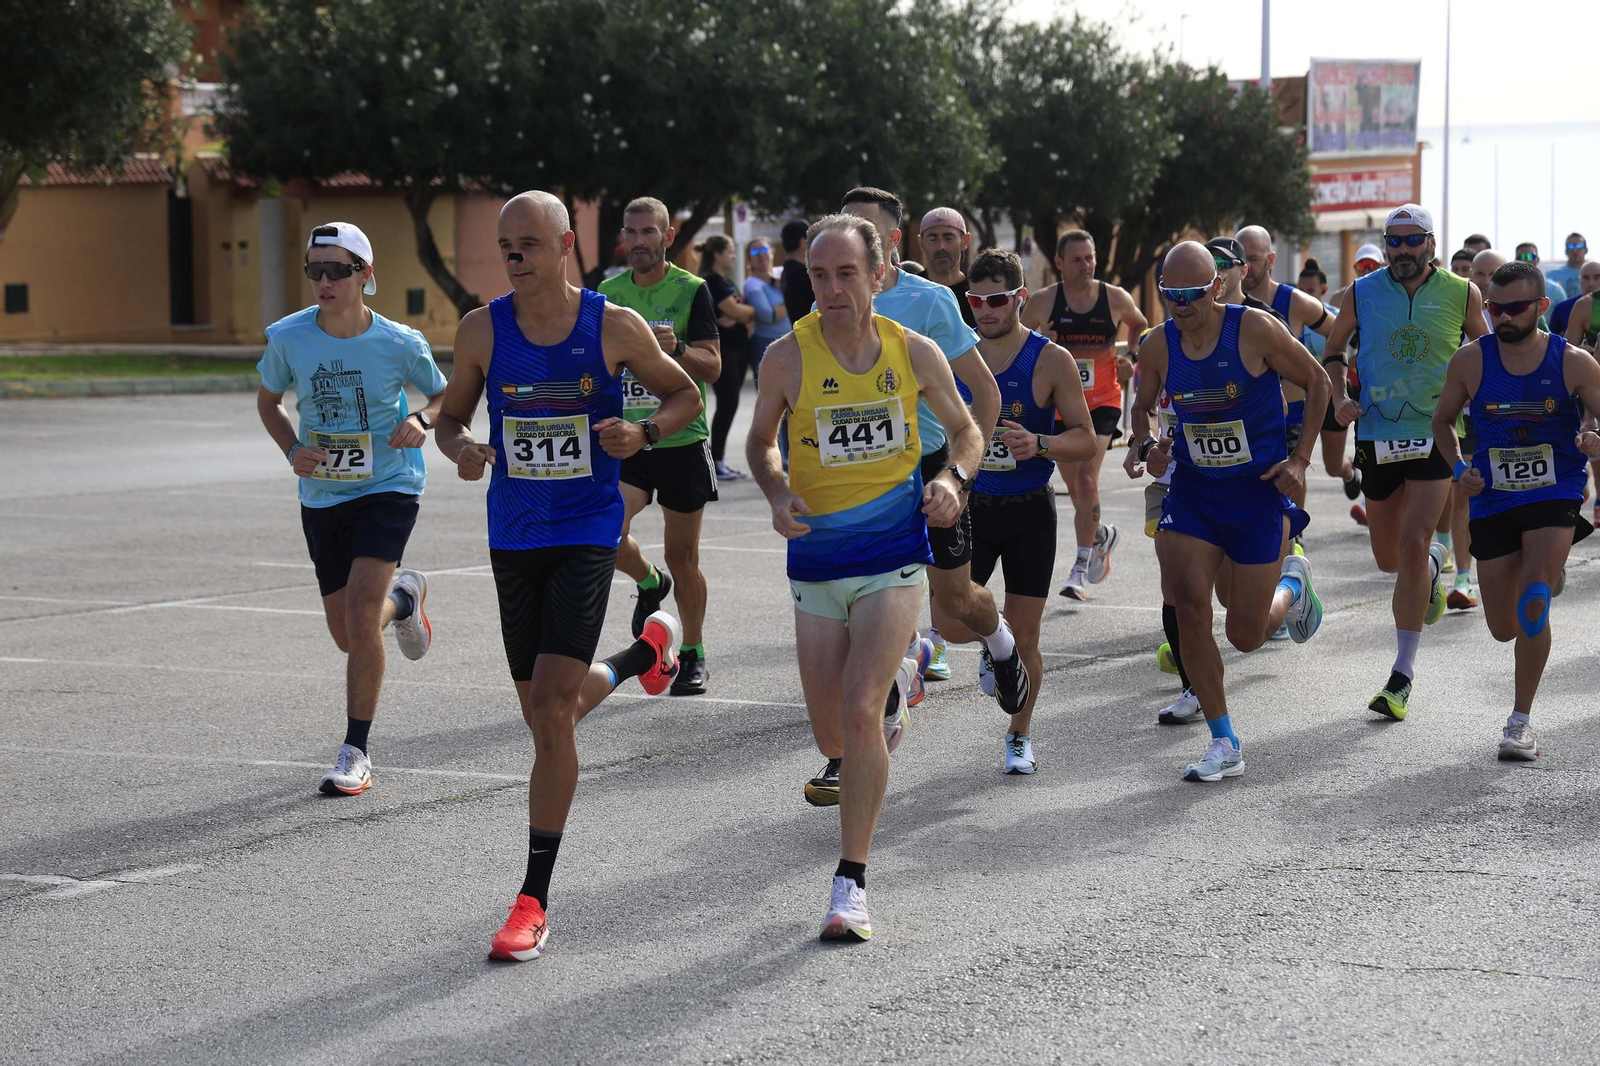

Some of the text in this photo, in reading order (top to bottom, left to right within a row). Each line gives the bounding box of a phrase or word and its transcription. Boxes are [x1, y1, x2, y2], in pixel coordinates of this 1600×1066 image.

[330, 359, 343, 372] XXV
[336, 375, 363, 388] URBANA
[623, 382, 652, 397] 46
[862, 407, 889, 416] URBANA
[862, 413, 890, 423] ALGECIRAS
[828, 419, 893, 447] 441
[513, 436, 582, 461] 314
[1194, 437, 1241, 455] 100
[320, 448, 364, 468] 72
[1498, 460, 1547, 479] 120
